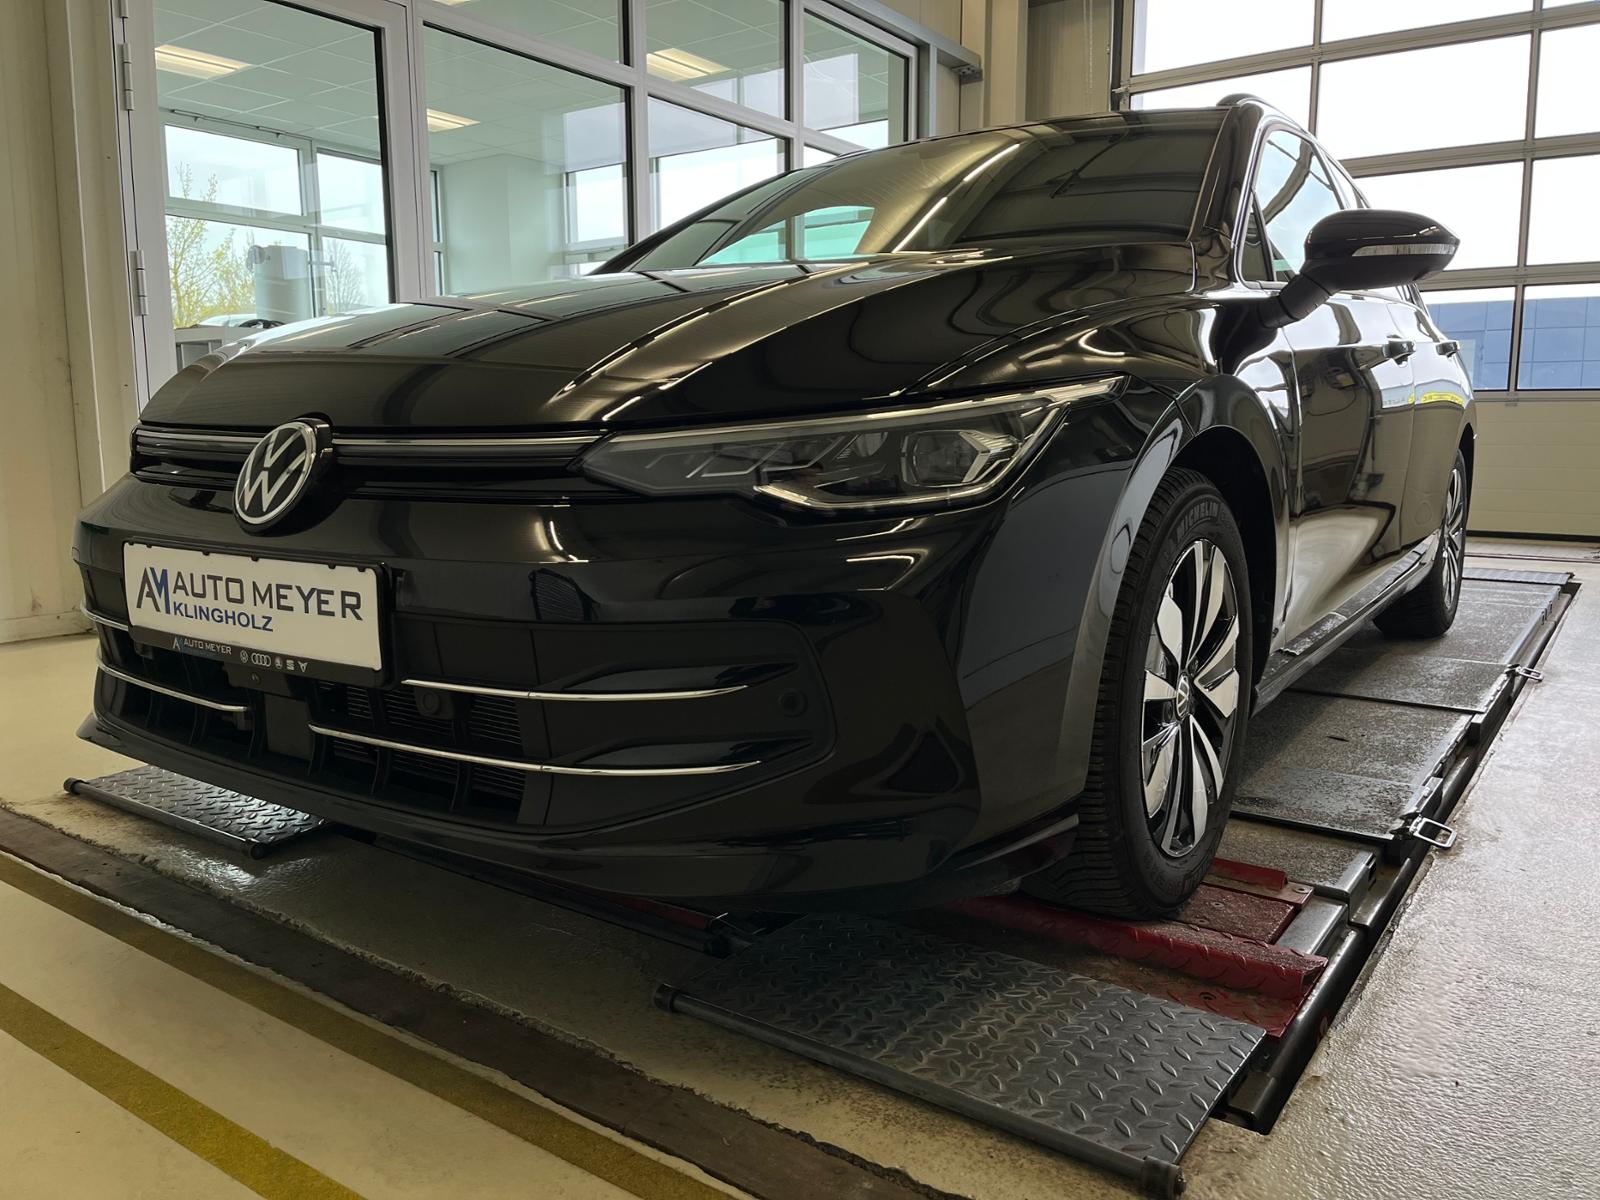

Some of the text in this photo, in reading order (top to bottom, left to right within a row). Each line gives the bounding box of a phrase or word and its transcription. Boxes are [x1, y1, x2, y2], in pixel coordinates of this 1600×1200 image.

[236, 424, 315, 520] VW
[172, 571, 363, 621] AUTO MEYER
[173, 602, 273, 632] KLINGHOLZ
[183, 638, 204, 649] AUTO
[204, 642, 232, 655] MEYER
